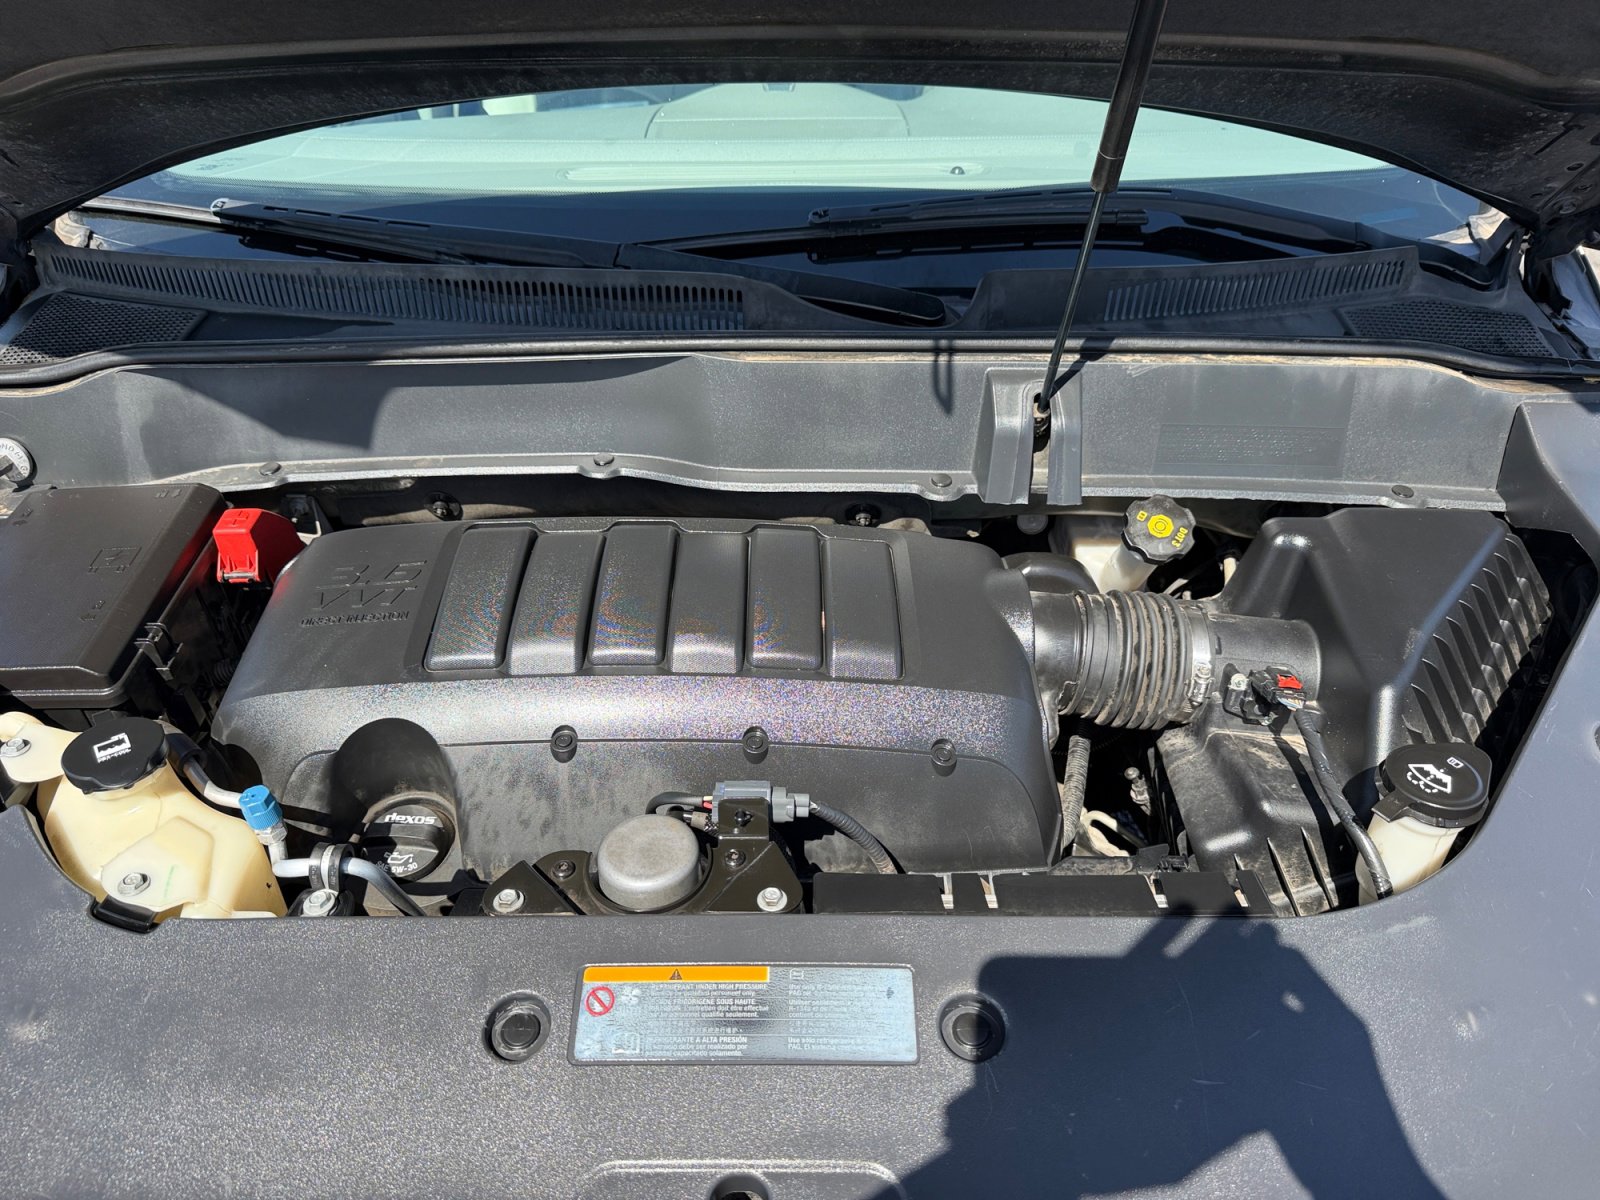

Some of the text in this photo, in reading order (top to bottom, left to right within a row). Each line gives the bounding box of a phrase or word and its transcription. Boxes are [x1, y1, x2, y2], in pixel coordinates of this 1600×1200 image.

[300, 610, 410, 627] DIRECT INJECTION
[384, 812, 438, 825] dexos
[391, 862, 418, 873] 5W-30
[719, 1034, 748, 1043] PRESIÓN
